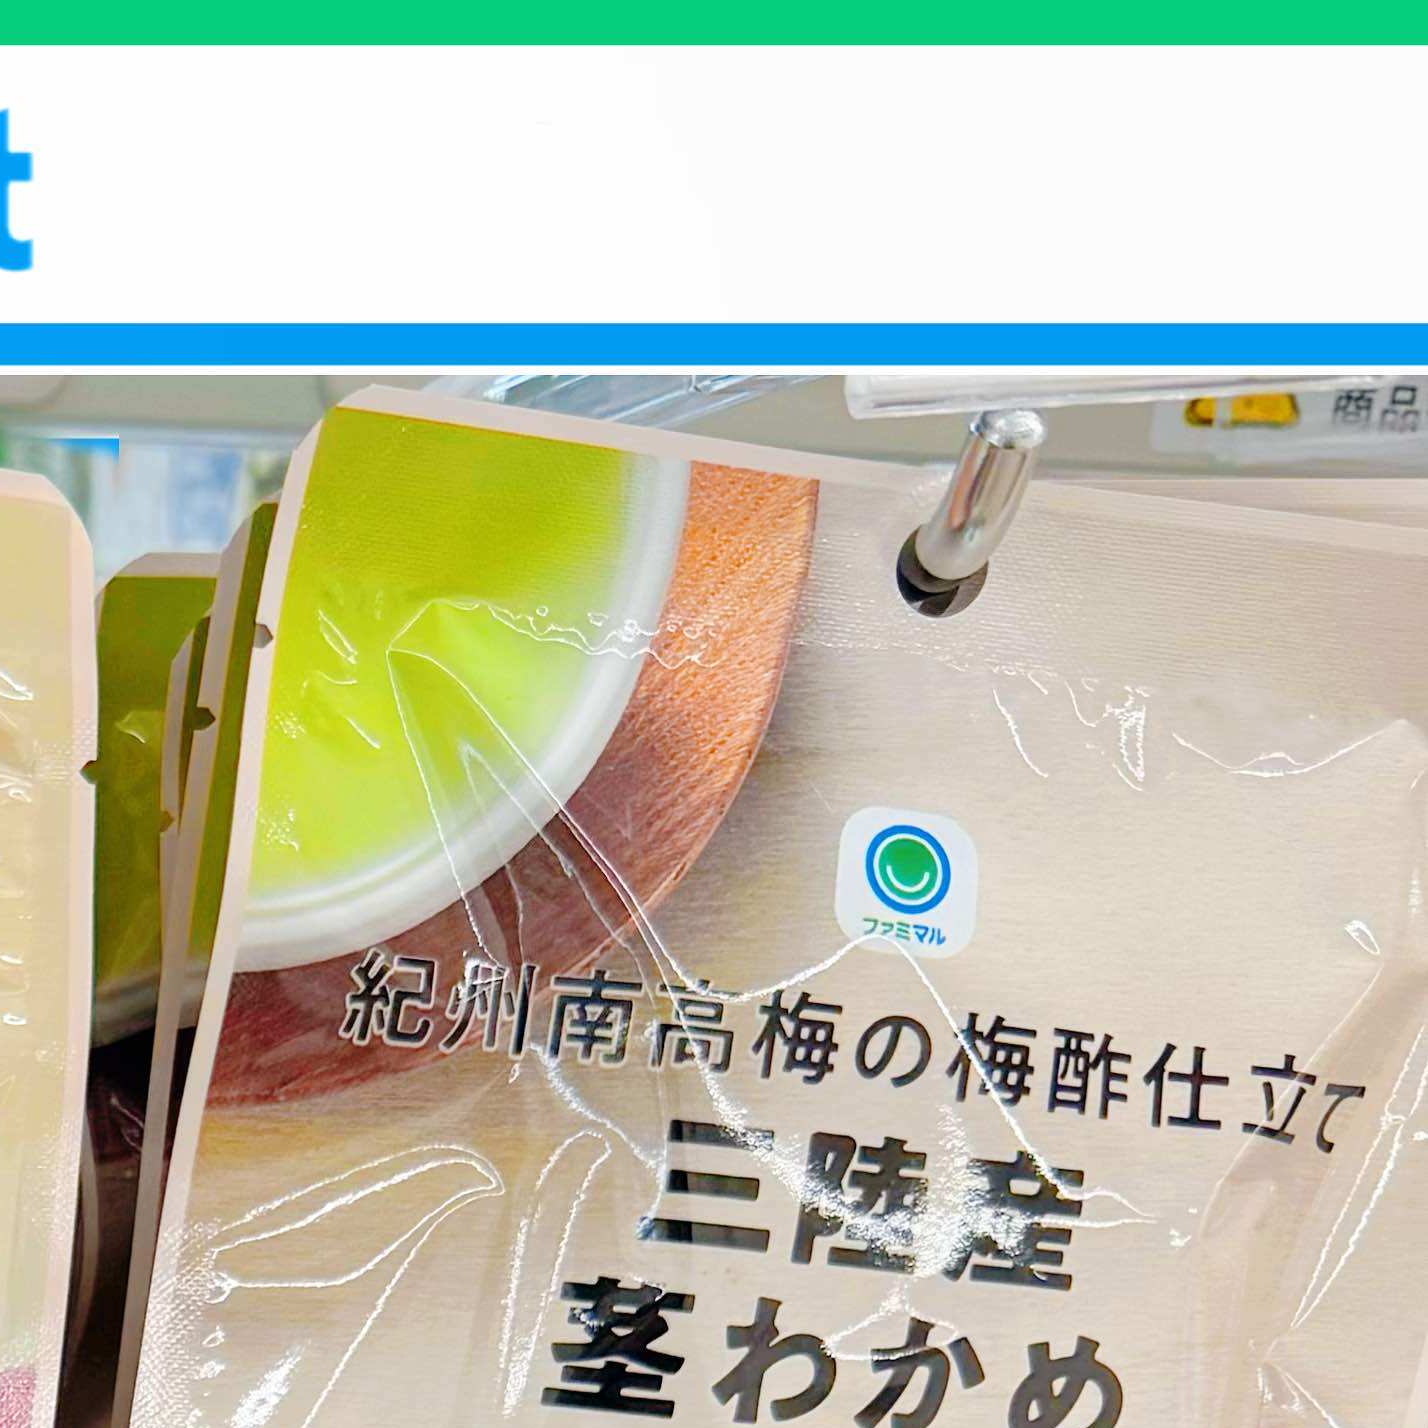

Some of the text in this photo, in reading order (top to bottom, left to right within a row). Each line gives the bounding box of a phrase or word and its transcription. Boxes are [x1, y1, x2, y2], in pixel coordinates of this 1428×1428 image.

[861, 916, 947, 948] ファミマル
[340, 946, 1368, 1155] 紀州南高梅の梅酢仕立て
[638, 1118, 1088, 1292] 三陸産
